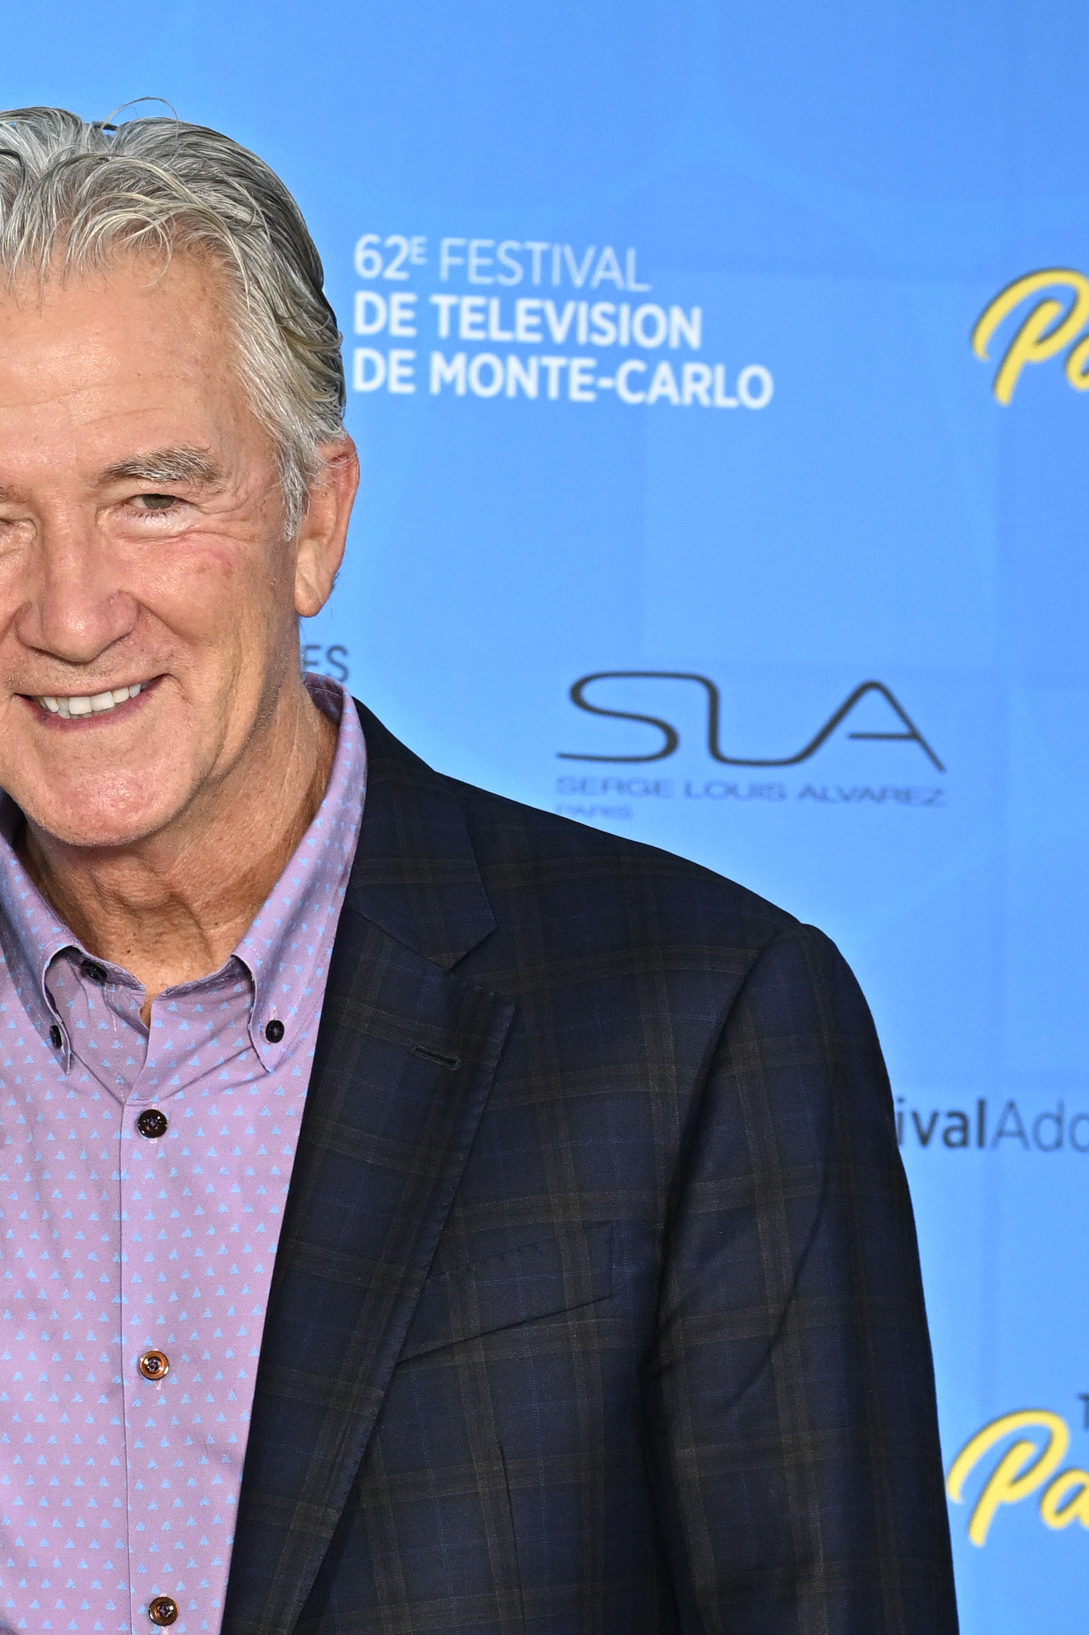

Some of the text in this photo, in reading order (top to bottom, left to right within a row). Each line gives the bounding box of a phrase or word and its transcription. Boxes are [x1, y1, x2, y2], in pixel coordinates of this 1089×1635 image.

[440, 237, 652, 293] FESTIVAL
[353, 290, 702, 351] DE TELEVISION
[353, 347, 774, 410] DE MONTE-CARLO
[556, 671, 946, 773] SLA
[556, 775, 945, 808] SERGE LOUIS ALVAREZ
